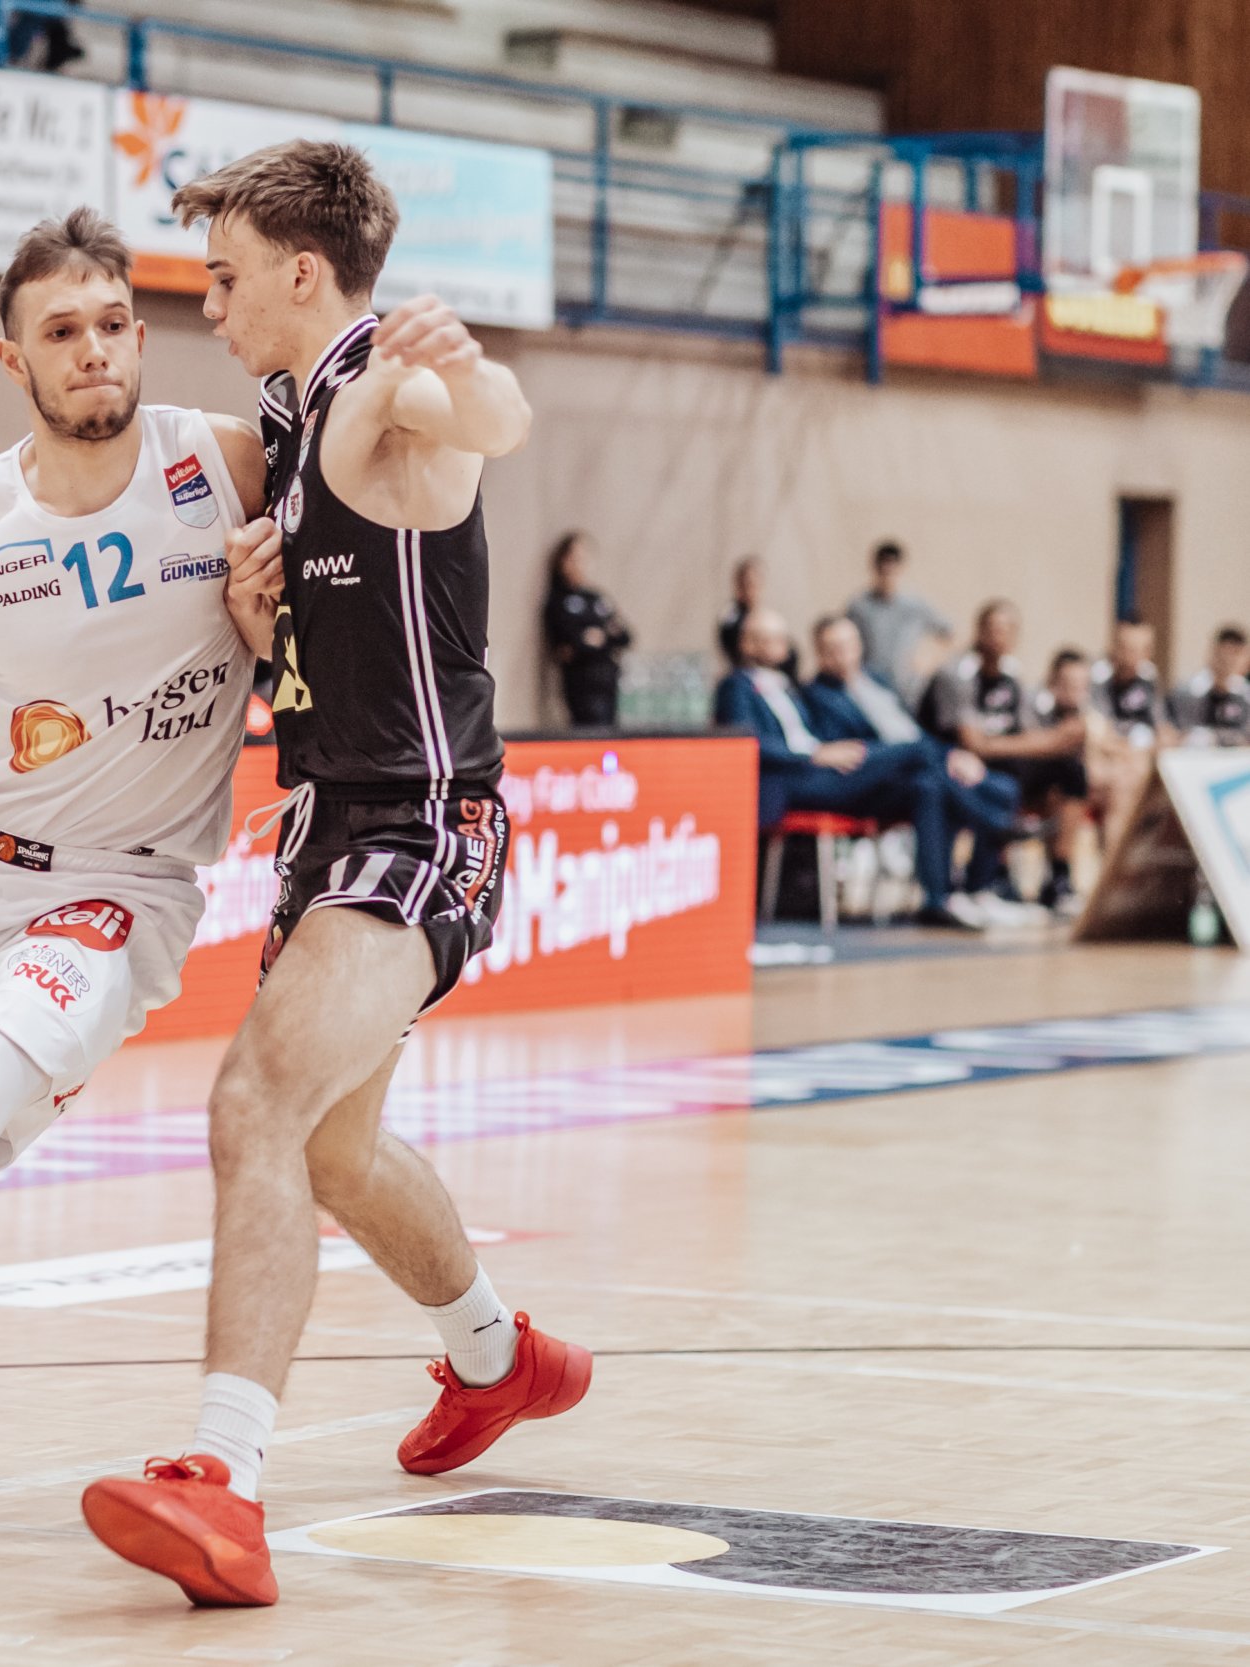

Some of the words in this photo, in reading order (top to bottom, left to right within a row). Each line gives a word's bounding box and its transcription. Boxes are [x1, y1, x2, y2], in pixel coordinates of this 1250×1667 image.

[62, 531, 145, 610] 12
[161, 558, 230, 582] GUNNERS
[331, 576, 361, 586] Gruppe
[138, 696, 217, 743] land
[16, 845, 50, 862] SPALDING
[32, 905, 125, 940] Keli
[13, 962, 77, 1012] DRUCK
